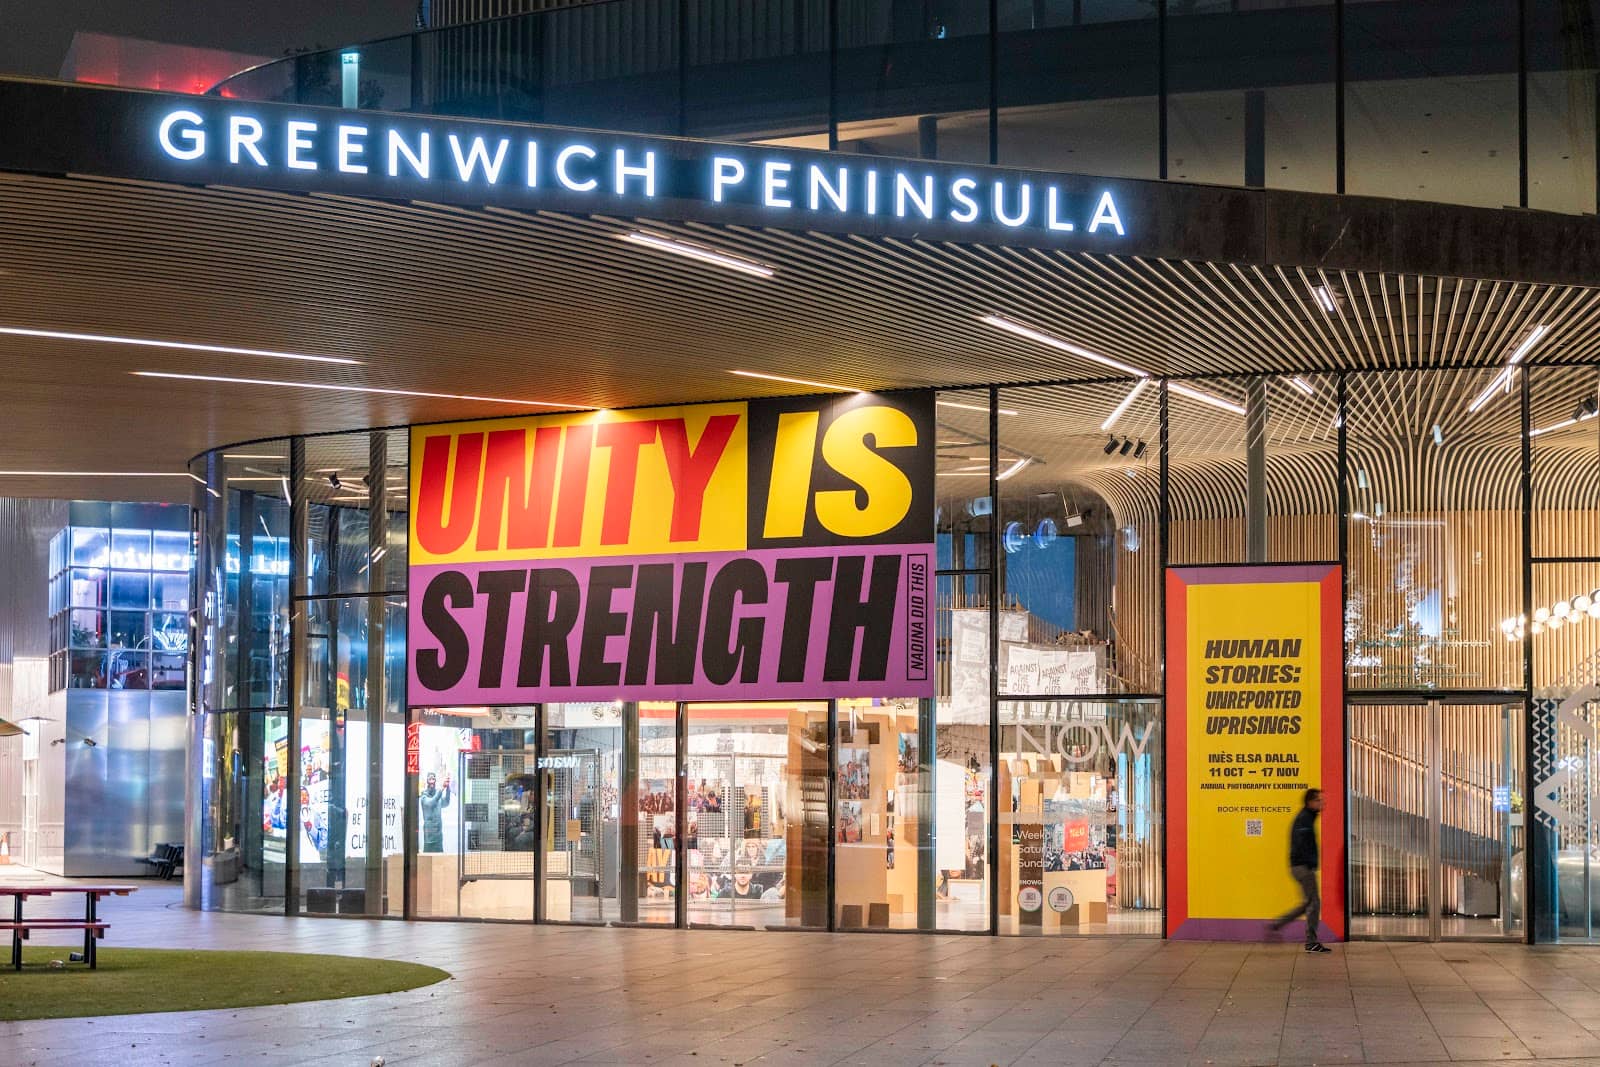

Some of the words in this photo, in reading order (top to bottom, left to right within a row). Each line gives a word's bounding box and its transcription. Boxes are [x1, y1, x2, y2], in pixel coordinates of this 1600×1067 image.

[157, 109, 657, 199] GREENWICH
[711, 155, 1127, 238] PENINSULA
[416, 414, 742, 555] UNITY
[763, 406, 918, 539] IS
[911, 563, 925, 591] THIS
[911, 596, 925, 619] DID
[415, 554, 903, 691] STRENGTH
[911, 621, 925, 671] NADINA
[1205, 639, 1302, 659] HUMAN
[1205, 665, 1301, 684] STORIES:
[1205, 691, 1302, 710] UNREPORTED
[1206, 716, 1302, 735] UPRISINGS
[1016, 722, 1154, 764] NOW
[1209, 751, 1232, 763] INÈS
[1236, 754, 1262, 763] ELSA
[1265, 754, 1300, 763] DALAL
[1209, 768, 1221, 777] 11
[1224, 768, 1244, 777] OCT
[1261, 768, 1273, 777] 17
[1277, 768, 1300, 777] NOV
[352, 813, 362, 826] BE
[385, 813, 396, 827] MY
[1018, 858, 1055, 870] Sunday
